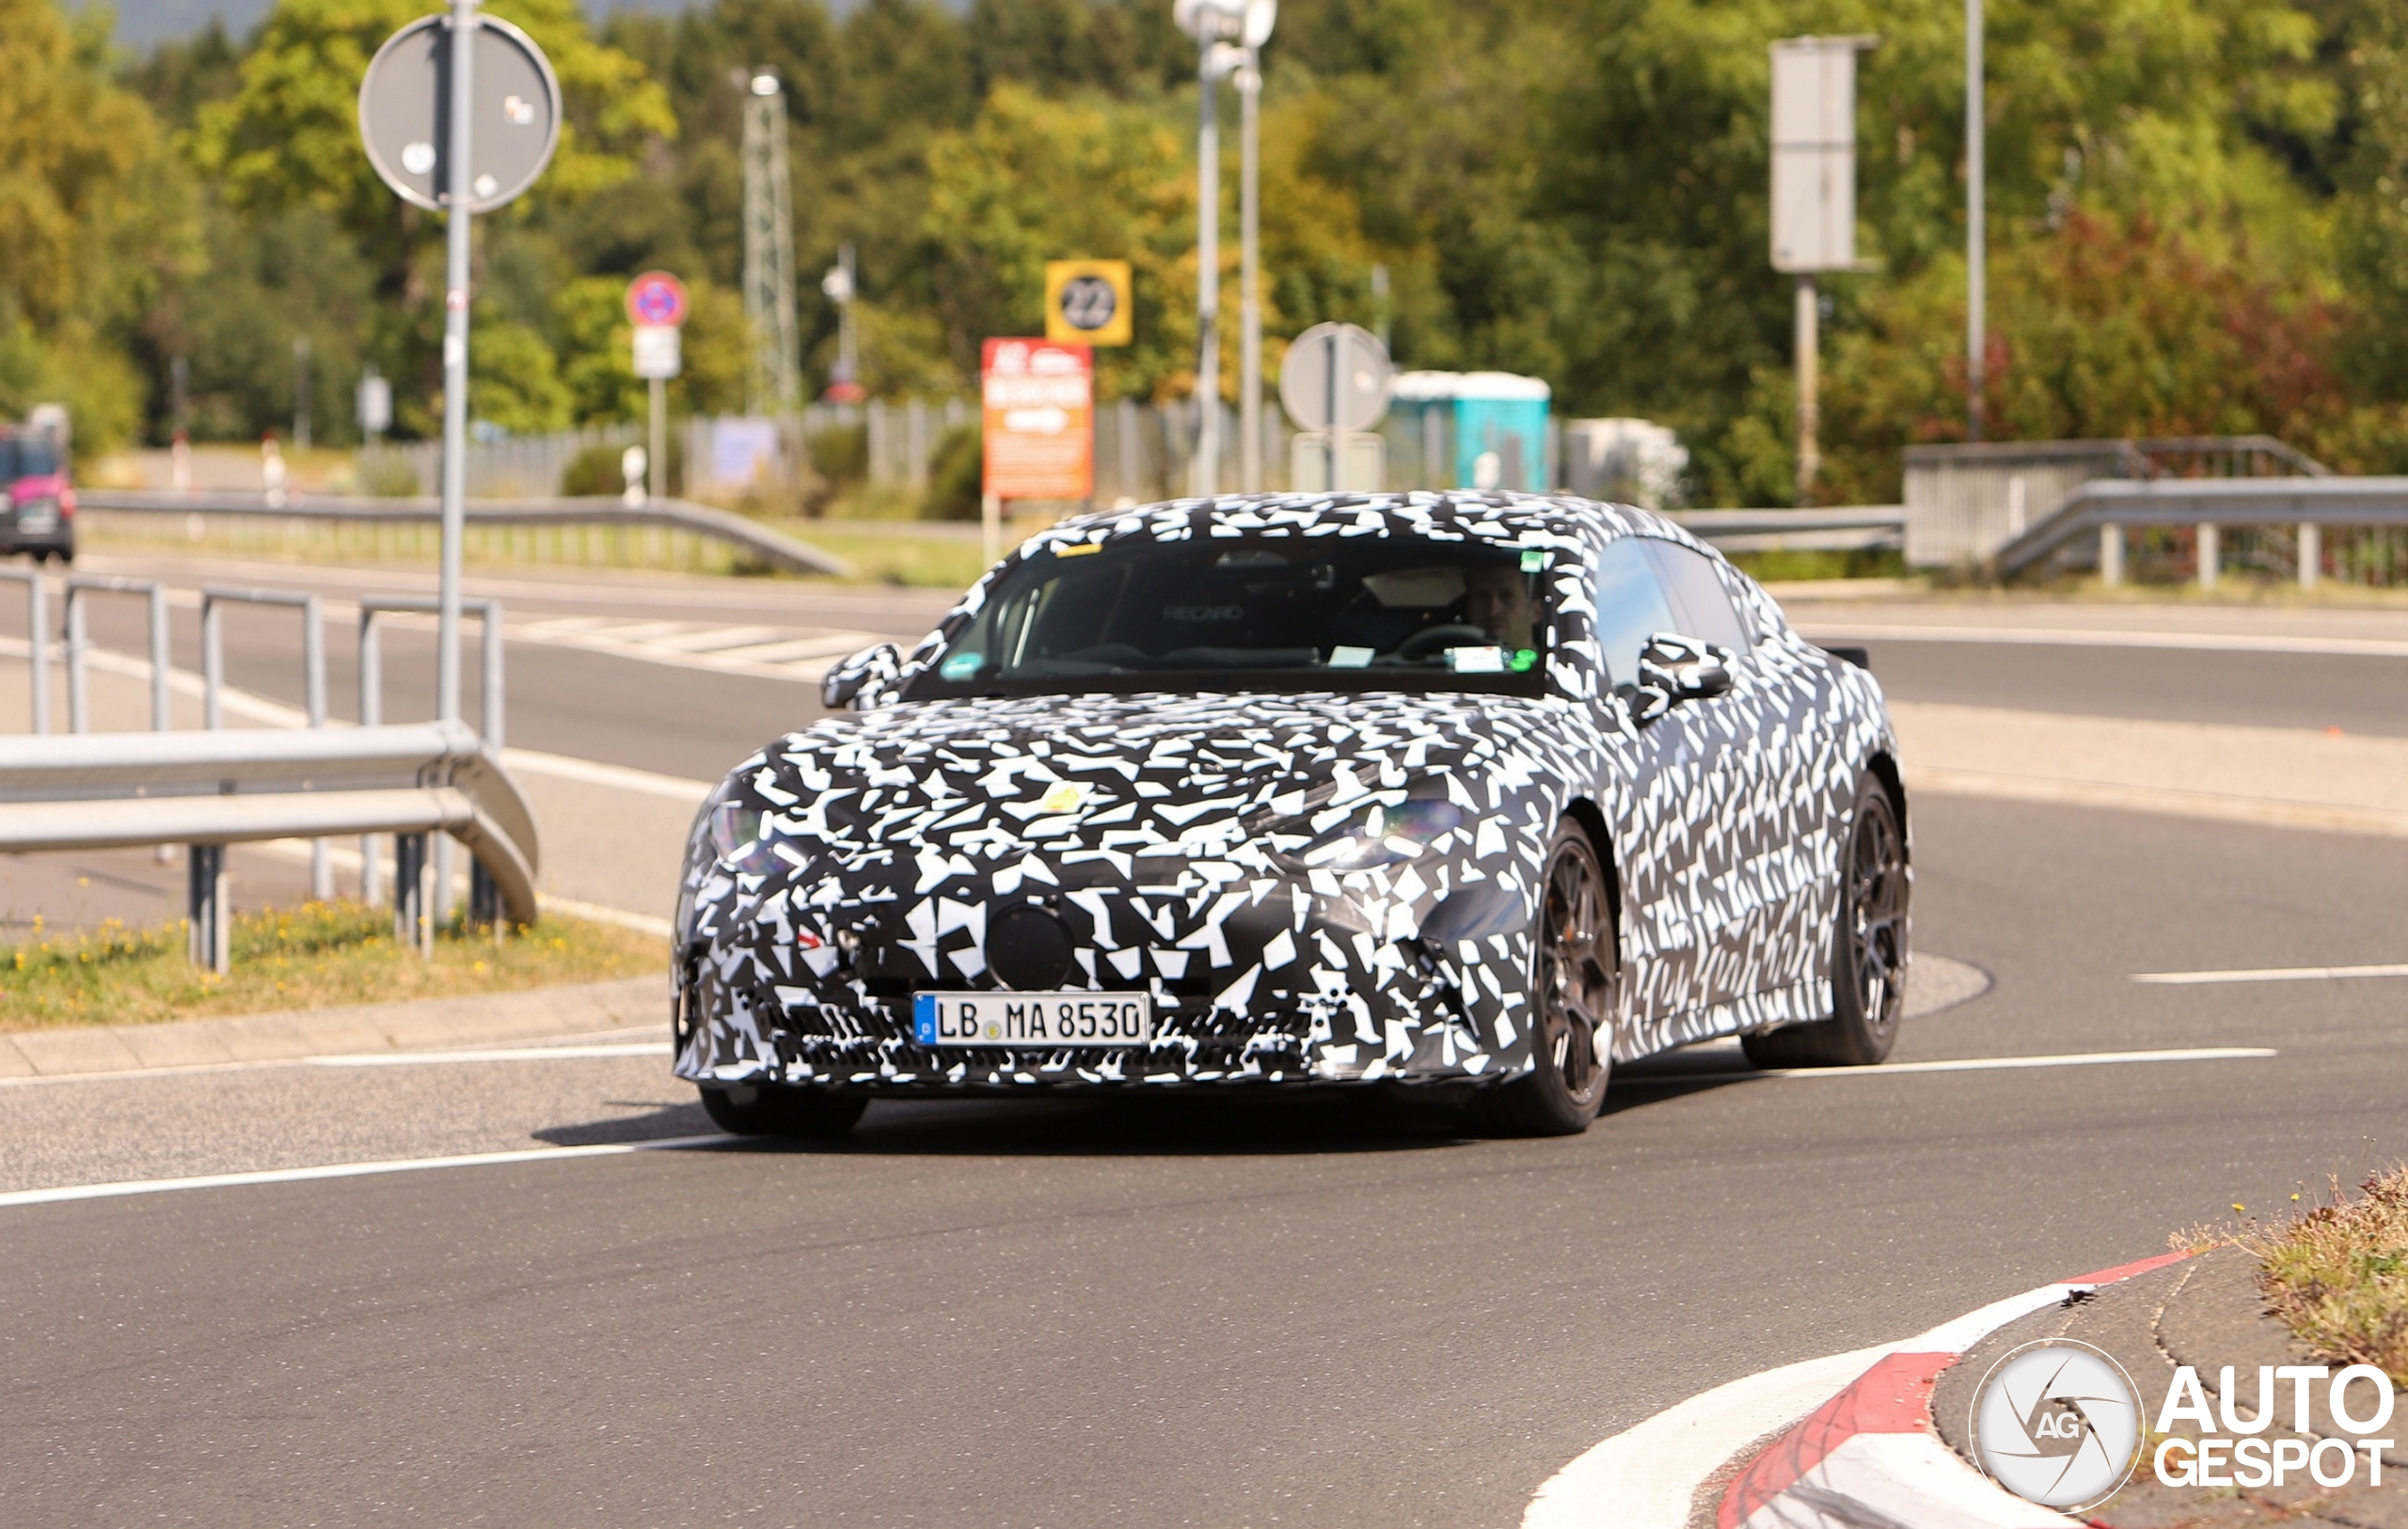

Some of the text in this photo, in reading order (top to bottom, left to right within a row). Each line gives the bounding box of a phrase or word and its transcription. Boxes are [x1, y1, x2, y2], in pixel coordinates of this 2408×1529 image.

[1062, 277, 1116, 328] 22
[939, 1003, 1140, 1038] LB MA 8530
